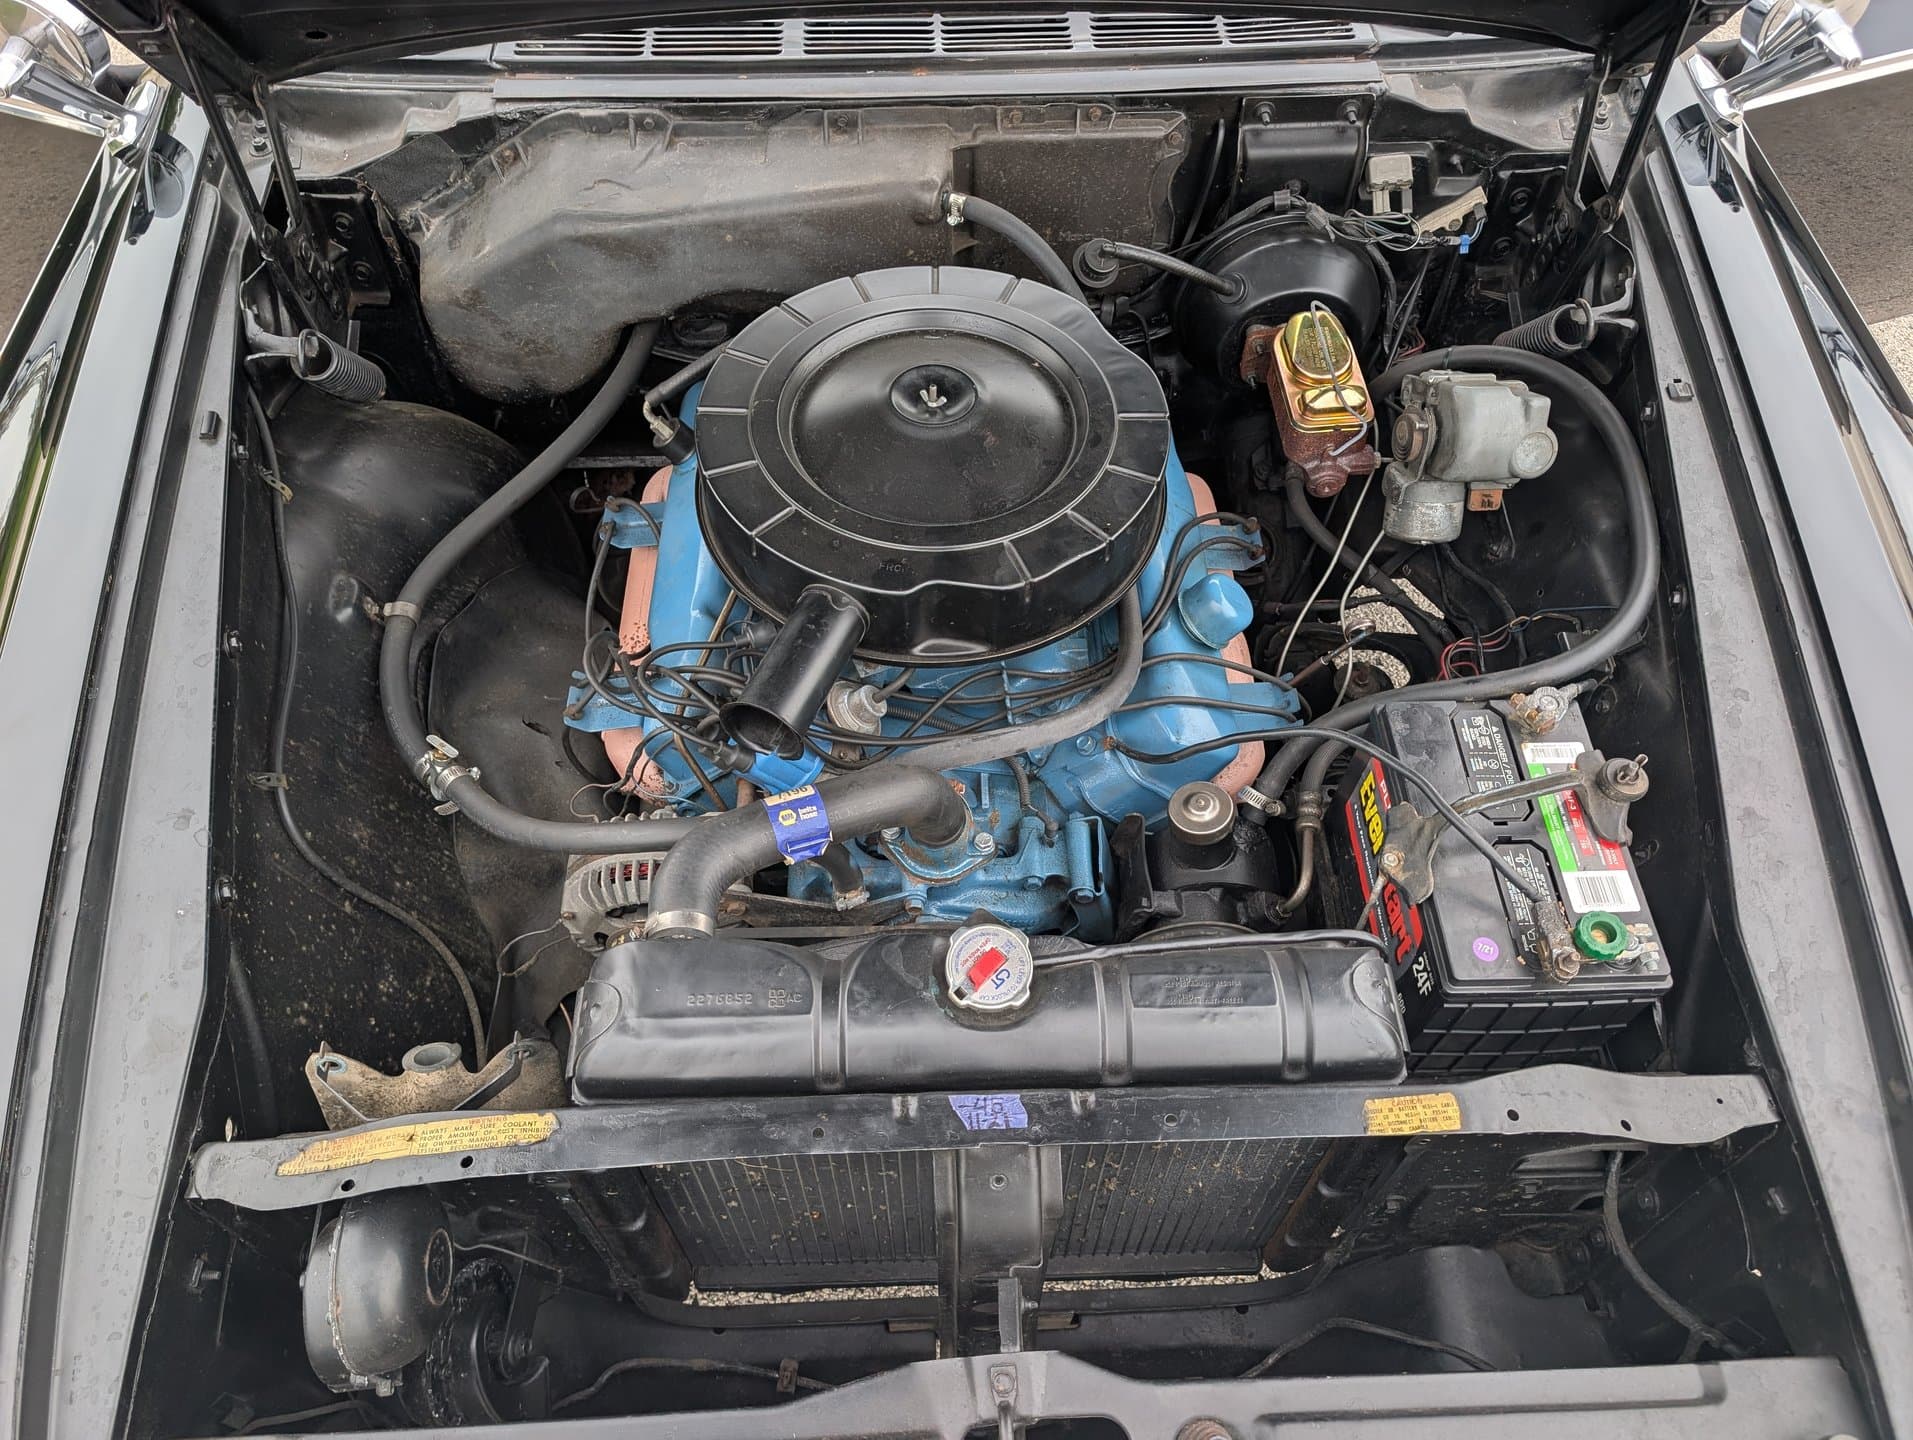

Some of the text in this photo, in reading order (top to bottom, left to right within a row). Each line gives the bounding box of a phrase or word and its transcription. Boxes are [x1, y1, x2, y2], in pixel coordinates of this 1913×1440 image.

[1494, 733, 1508, 763] DANGER
[1505, 770, 1514, 785] POIS
[991, 968, 1011, 990] CST
[1411, 956, 1433, 998] 24F
[1391, 1098, 1423, 1107] CAUTION
[448, 1131, 478, 1139] AMOUNT
[469, 1135, 498, 1143] MANUAL
